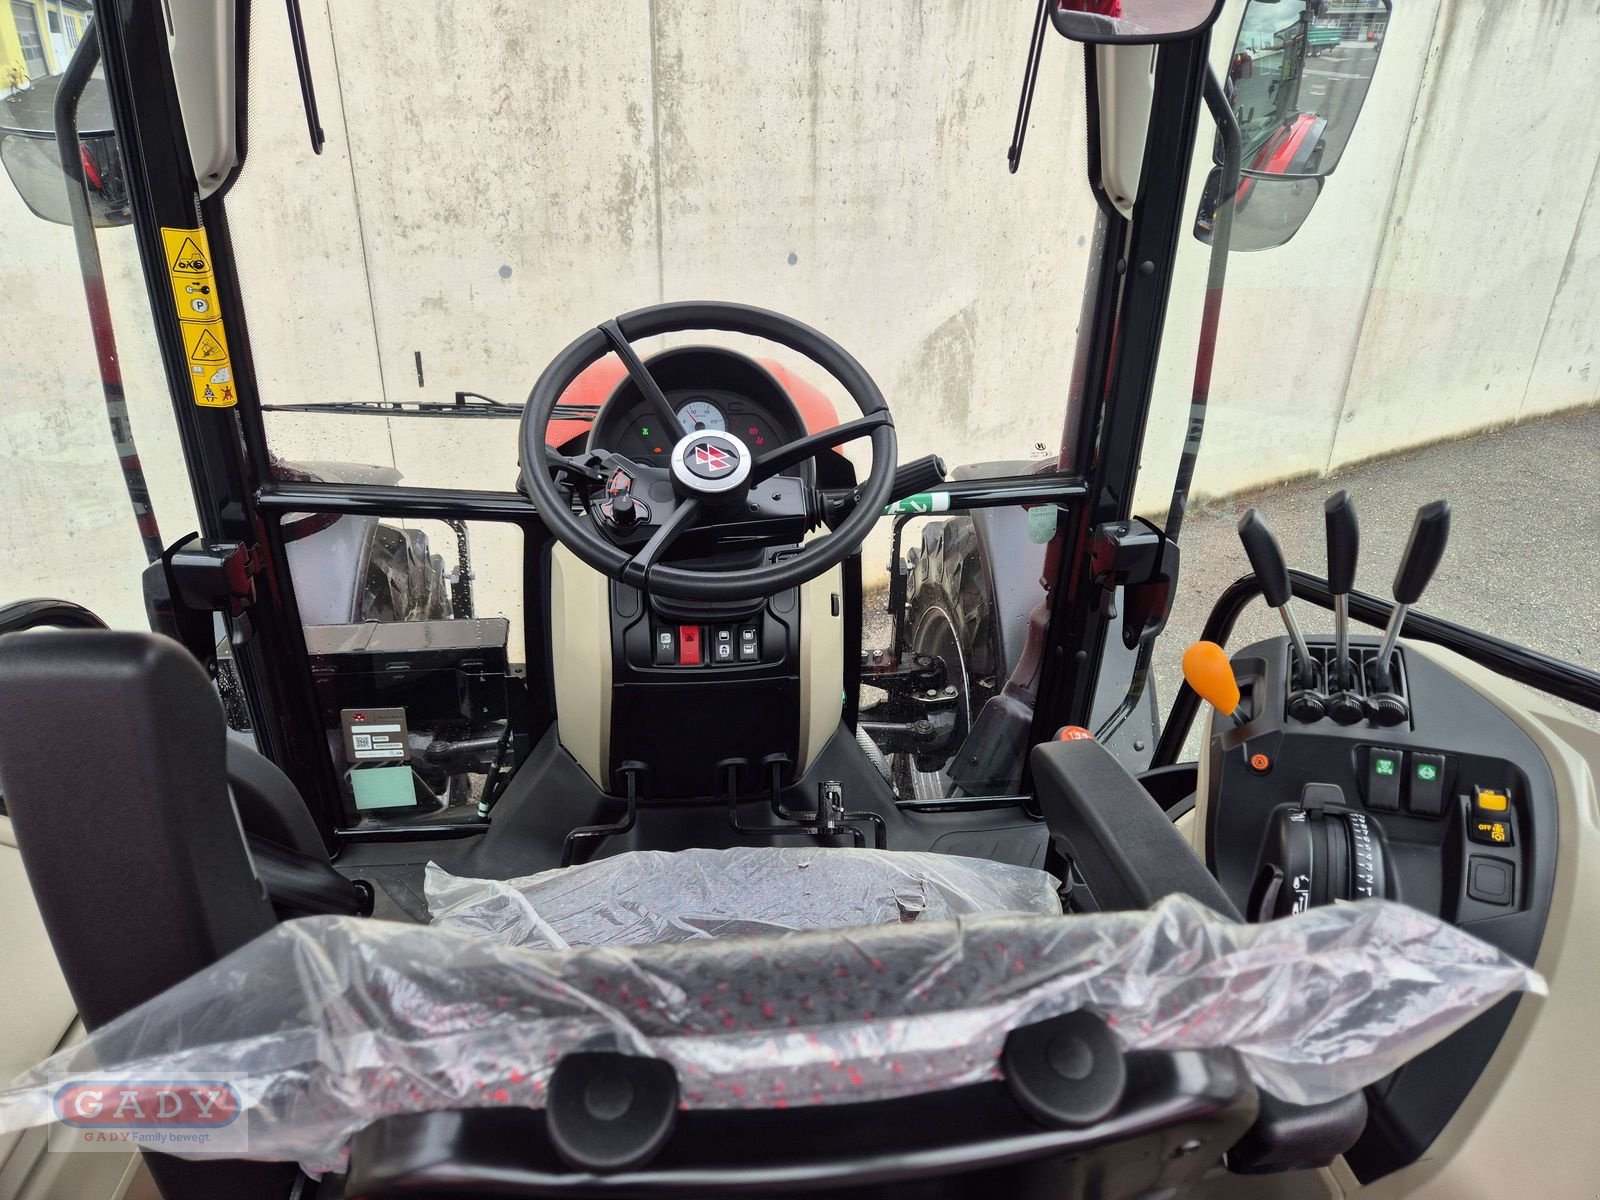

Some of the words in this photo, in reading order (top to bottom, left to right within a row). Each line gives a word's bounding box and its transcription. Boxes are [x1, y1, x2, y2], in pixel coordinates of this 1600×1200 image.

[197, 301, 204, 309] P
[1366, 863, 1374, 871] 3
[1366, 874, 1374, 884] 2
